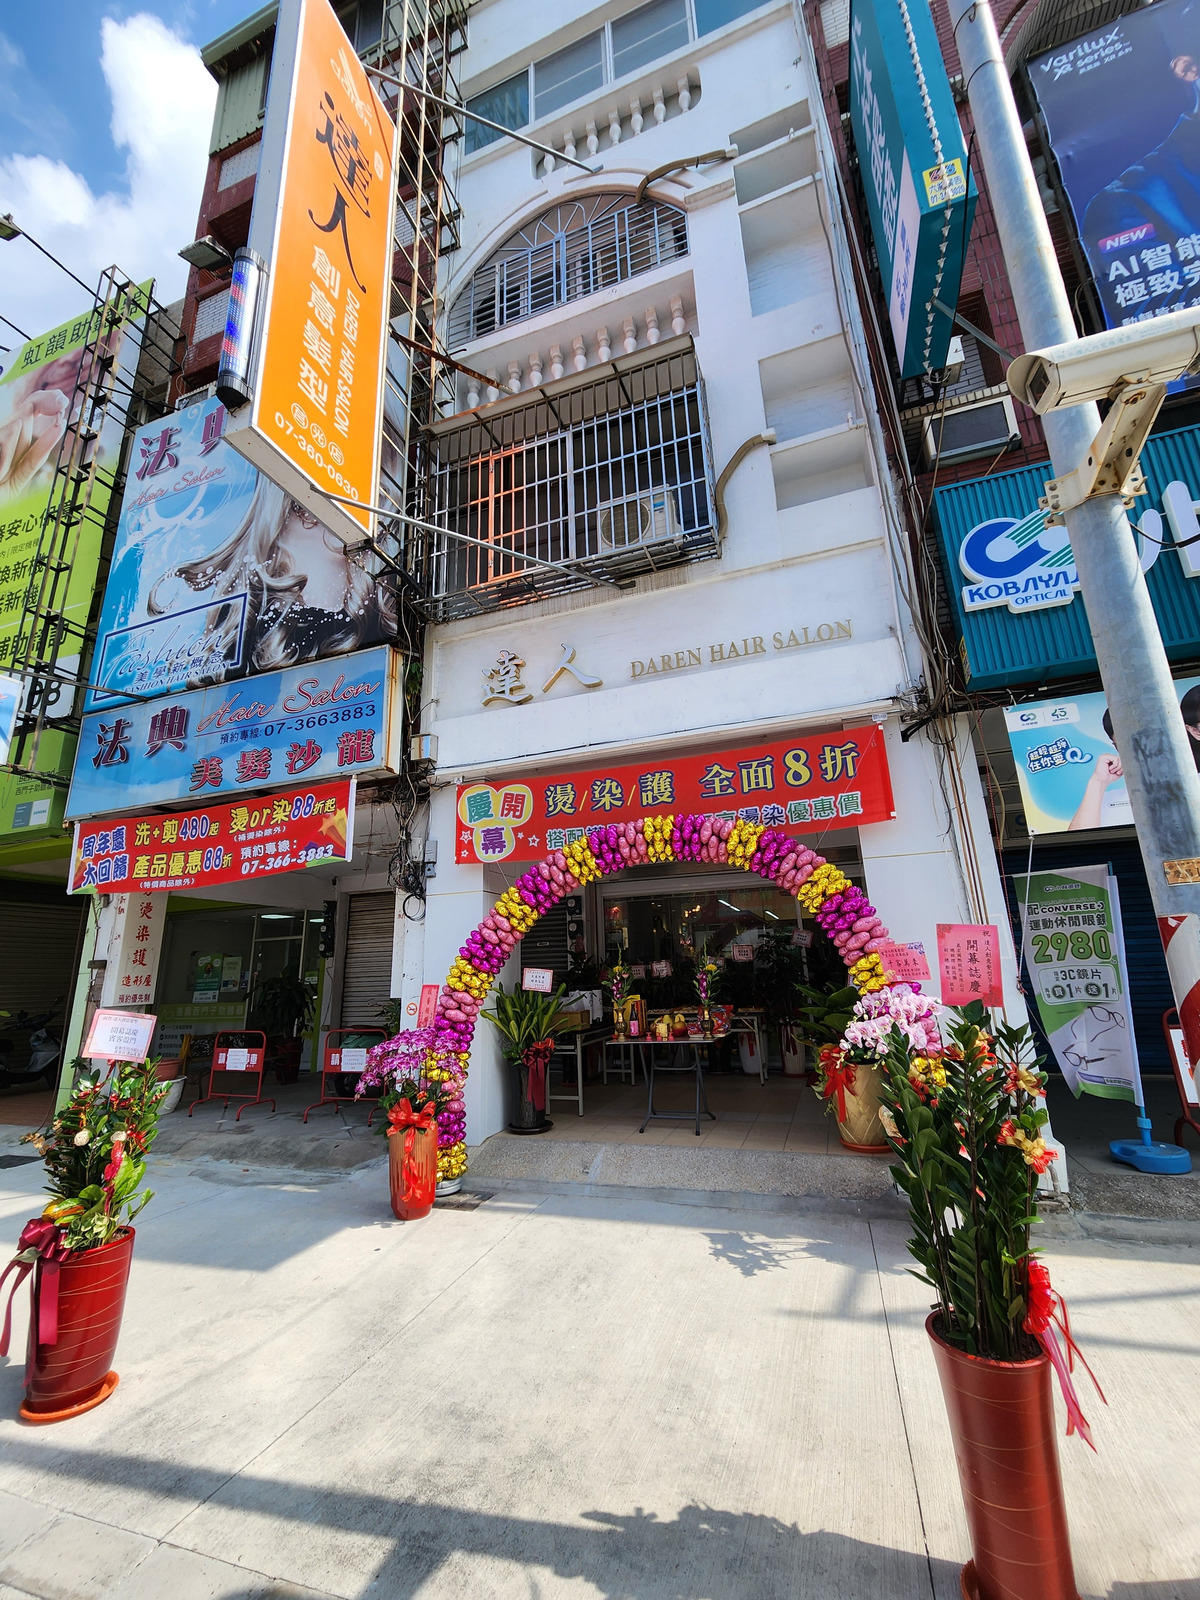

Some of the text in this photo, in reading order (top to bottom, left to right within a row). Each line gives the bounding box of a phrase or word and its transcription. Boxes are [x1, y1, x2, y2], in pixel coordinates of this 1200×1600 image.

[1076, 41, 1123, 68] series
[1106, 226, 1148, 250] NEW
[333, 377, 352, 438] SALON
[274, 412, 359, 500] 07-360-0630
[968, 571, 1079, 602] KOBAYA
[1015, 588, 1070, 606] OPTICAL
[630, 618, 853, 679] DAREN HAIR SALON
[133, 650, 225, 685] 美學新概念
[166, 670, 192, 685] HAIR
[481, 643, 604, 708] 達人
[195, 672, 382, 733] Hair Salon
[264, 702, 377, 738] 07-3663883
[91, 703, 189, 769] 法典
[189, 727, 376, 792] 美髮沙龍
[699, 740, 860, 798] 全面8折
[82, 826, 128, 861] 周年慶
[241, 844, 335, 876] 07-366-3883
[80, 854, 129, 888] 大回饋
[131, 846, 233, 880] 產品優惠88折
[1040, 902, 1096, 914] CONVERSE
[1031, 928, 1113, 965] 2980
[967, 939, 982, 993] 開幕誌慶
